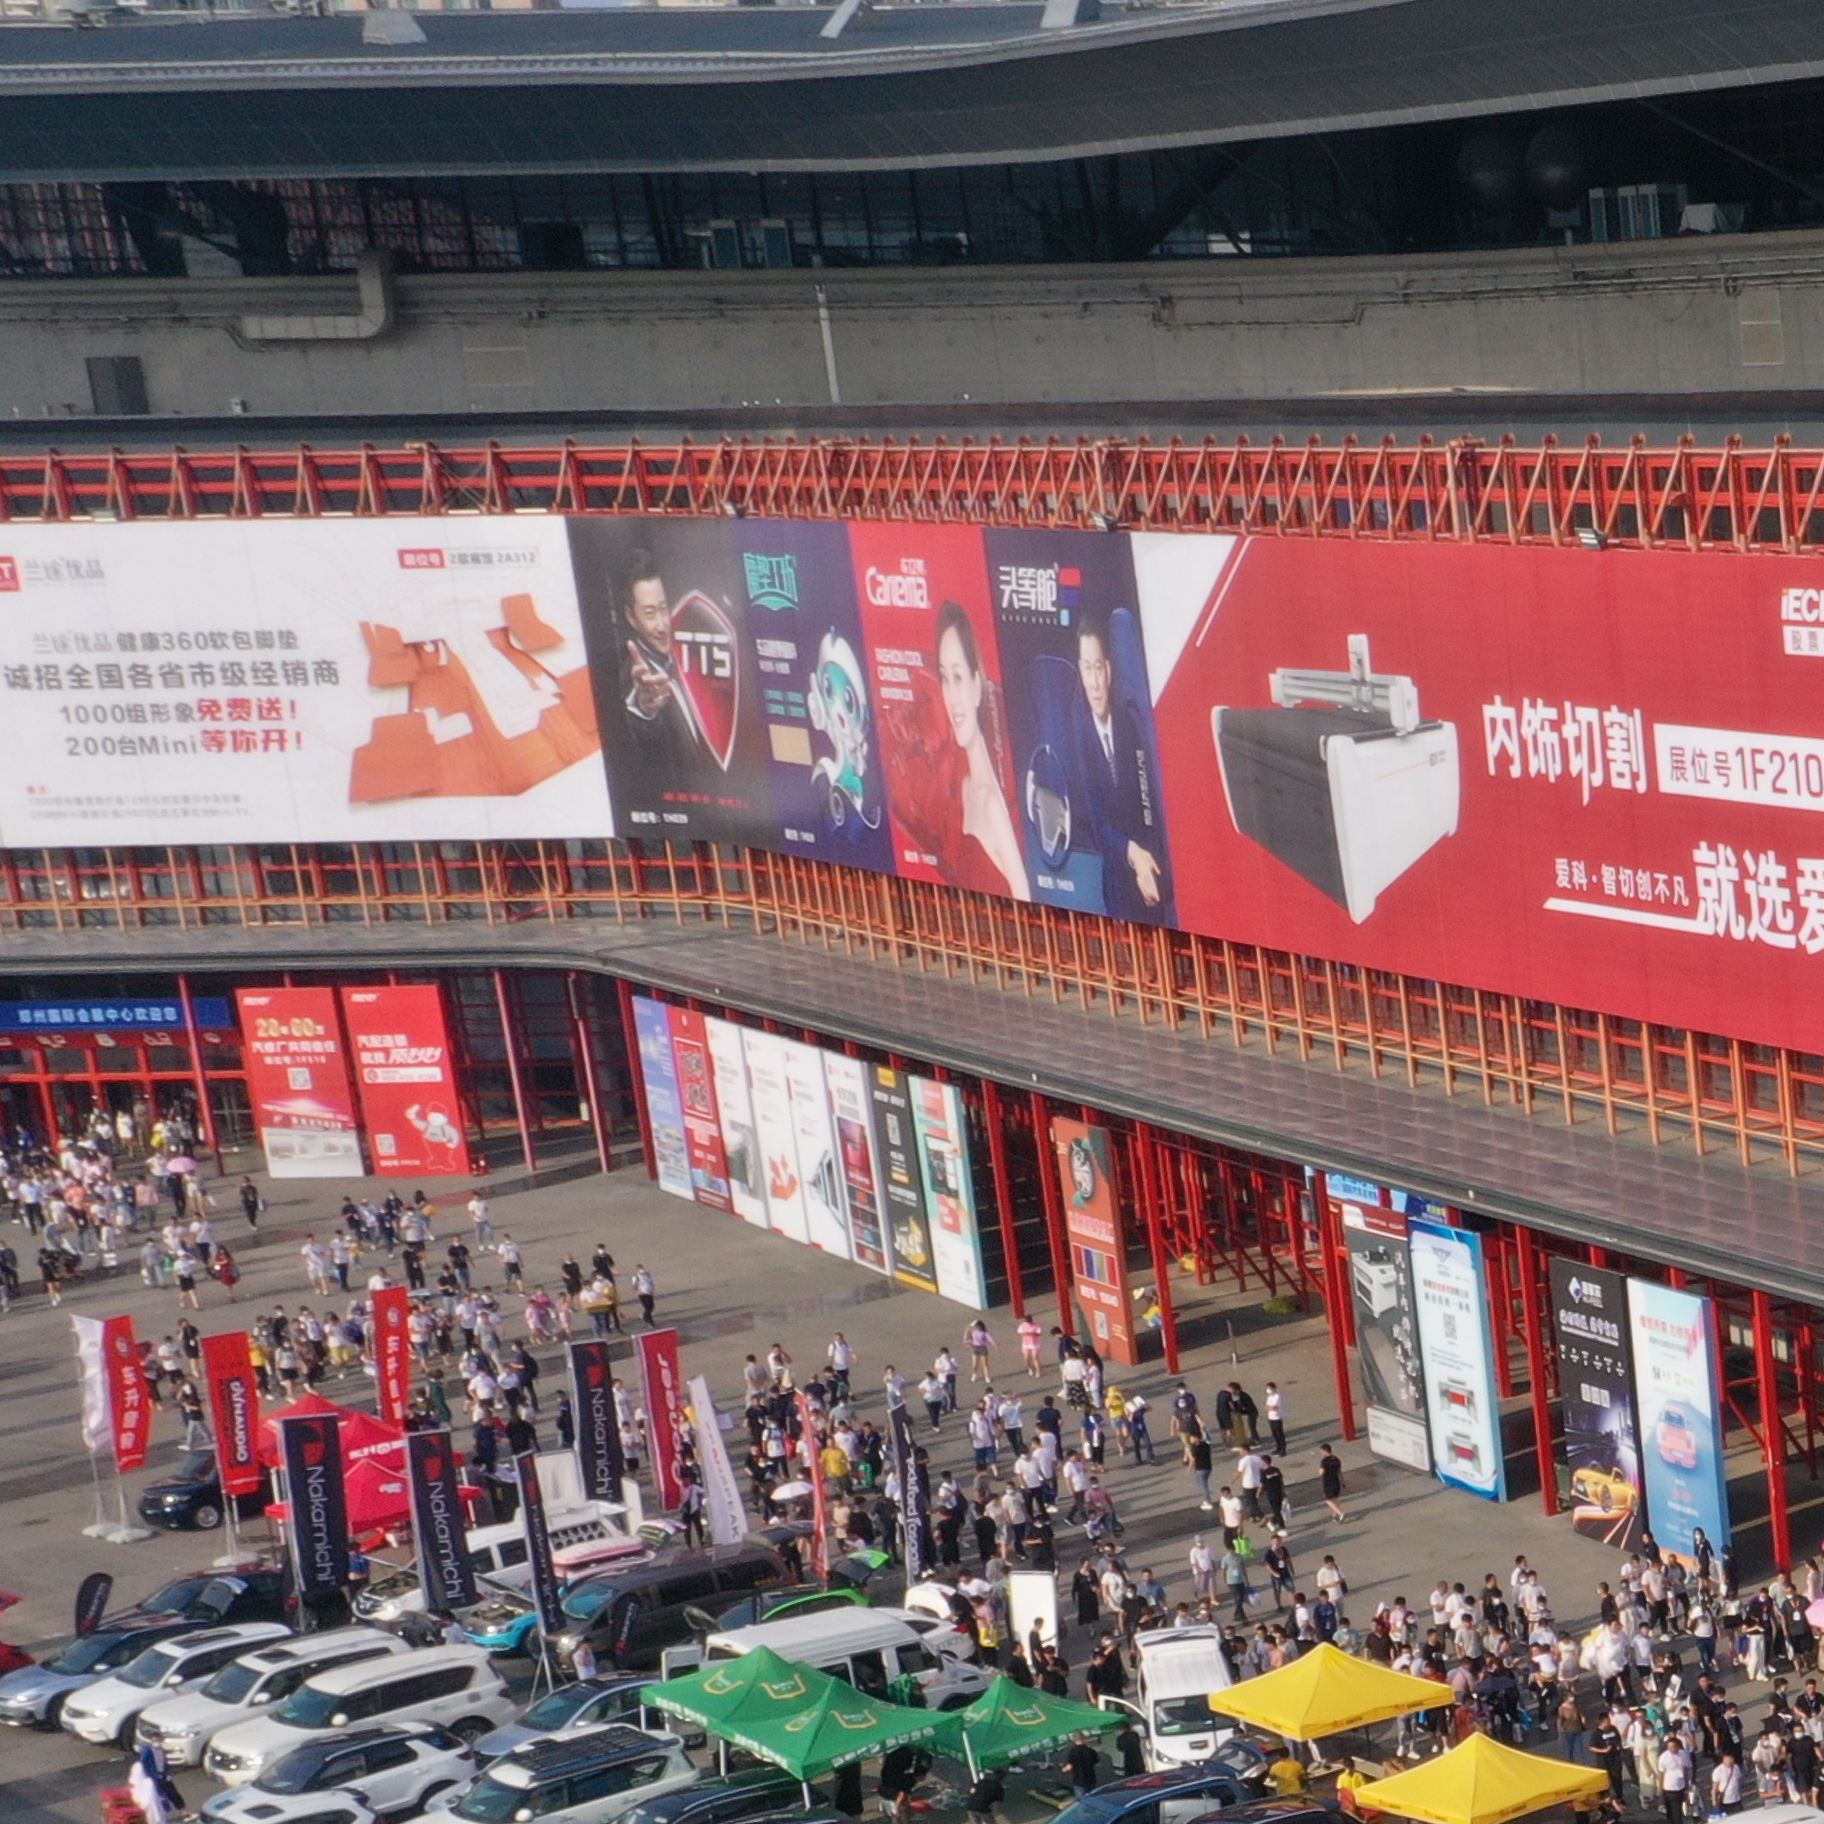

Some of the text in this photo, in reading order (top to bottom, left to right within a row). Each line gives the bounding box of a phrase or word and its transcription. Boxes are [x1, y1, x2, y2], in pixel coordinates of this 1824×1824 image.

[4, 660, 340, 691] 诚招全国各省市级经销商
[117, 630, 299, 652] 健康360软包脚垫
[60, 697, 297, 725] 1000组形象免费送!
[66, 729, 304, 757] 200台Mini等你开!
[1481, 694, 1649, 806] 内饰切割
[590, 1387, 615, 1498] Nakamichi
[305, 1465, 337, 1582] Nakamichi
[428, 1480, 466, 1602] Nakamichi
